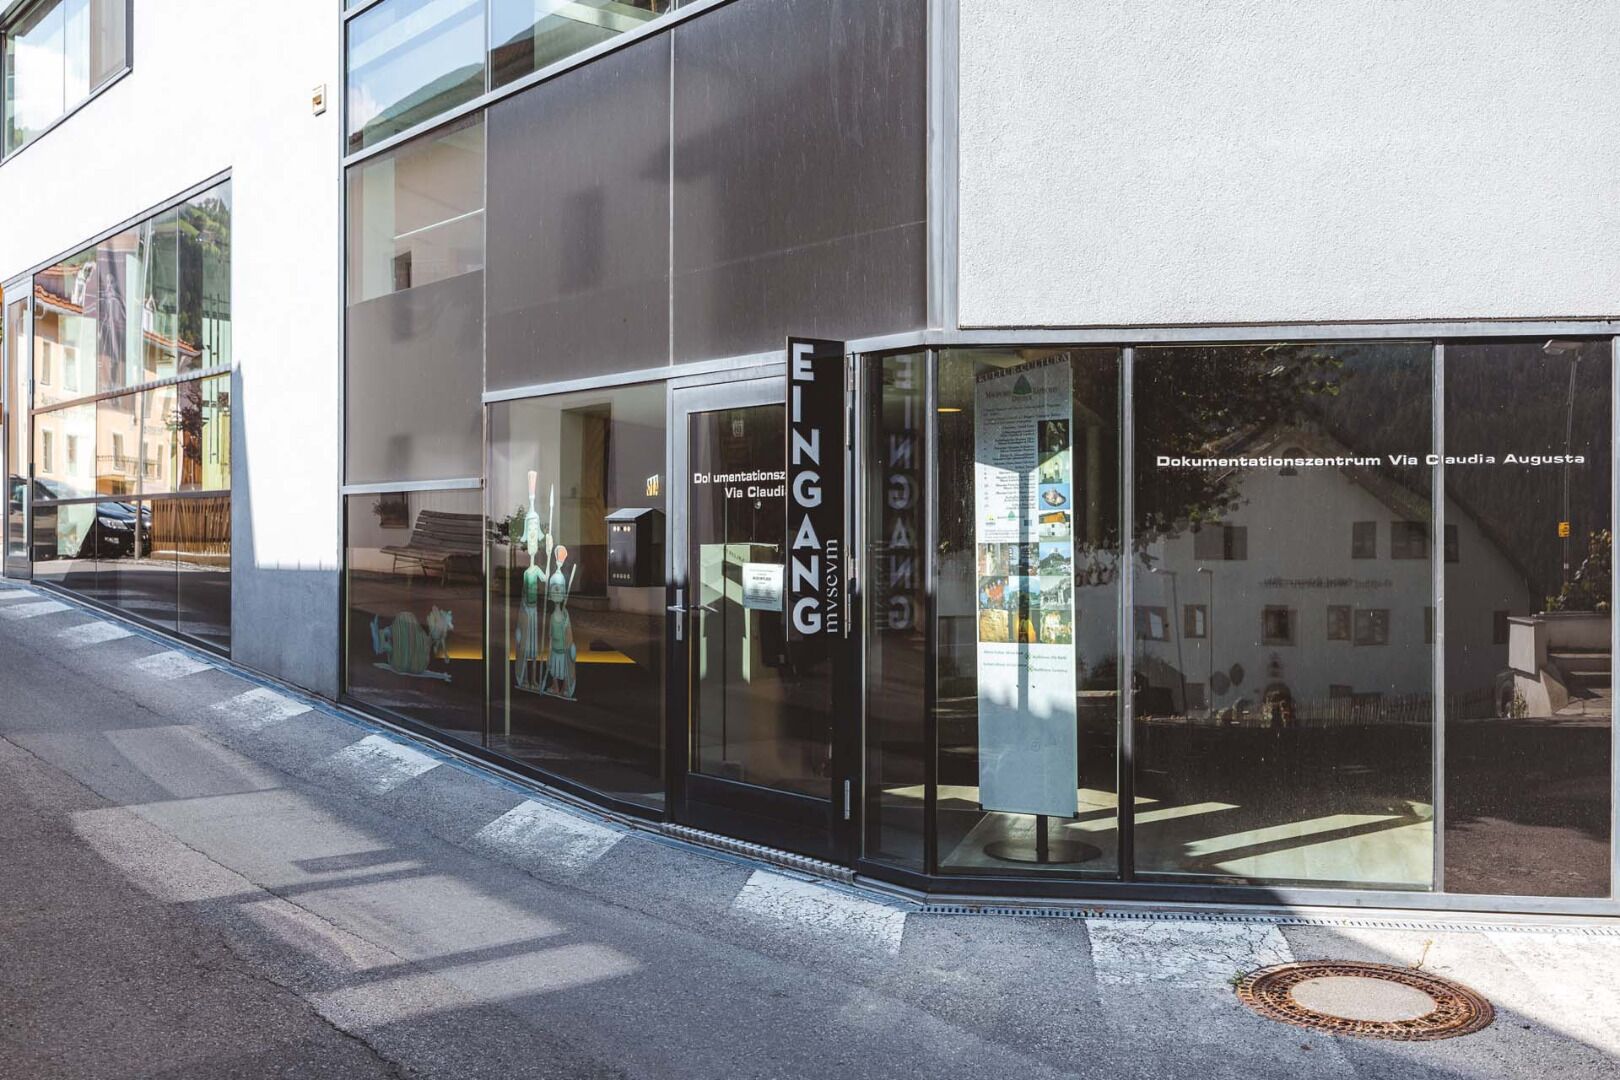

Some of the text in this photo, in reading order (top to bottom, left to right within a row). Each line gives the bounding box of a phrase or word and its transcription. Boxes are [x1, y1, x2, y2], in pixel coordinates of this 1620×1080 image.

[1156, 453, 1585, 467] Dokumentationszentrum Via Claudia Augusta
[724, 485, 787, 498] Via Claudi
[791, 343, 822, 635] EINGANG
[826, 539, 838, 633] mvsevm
